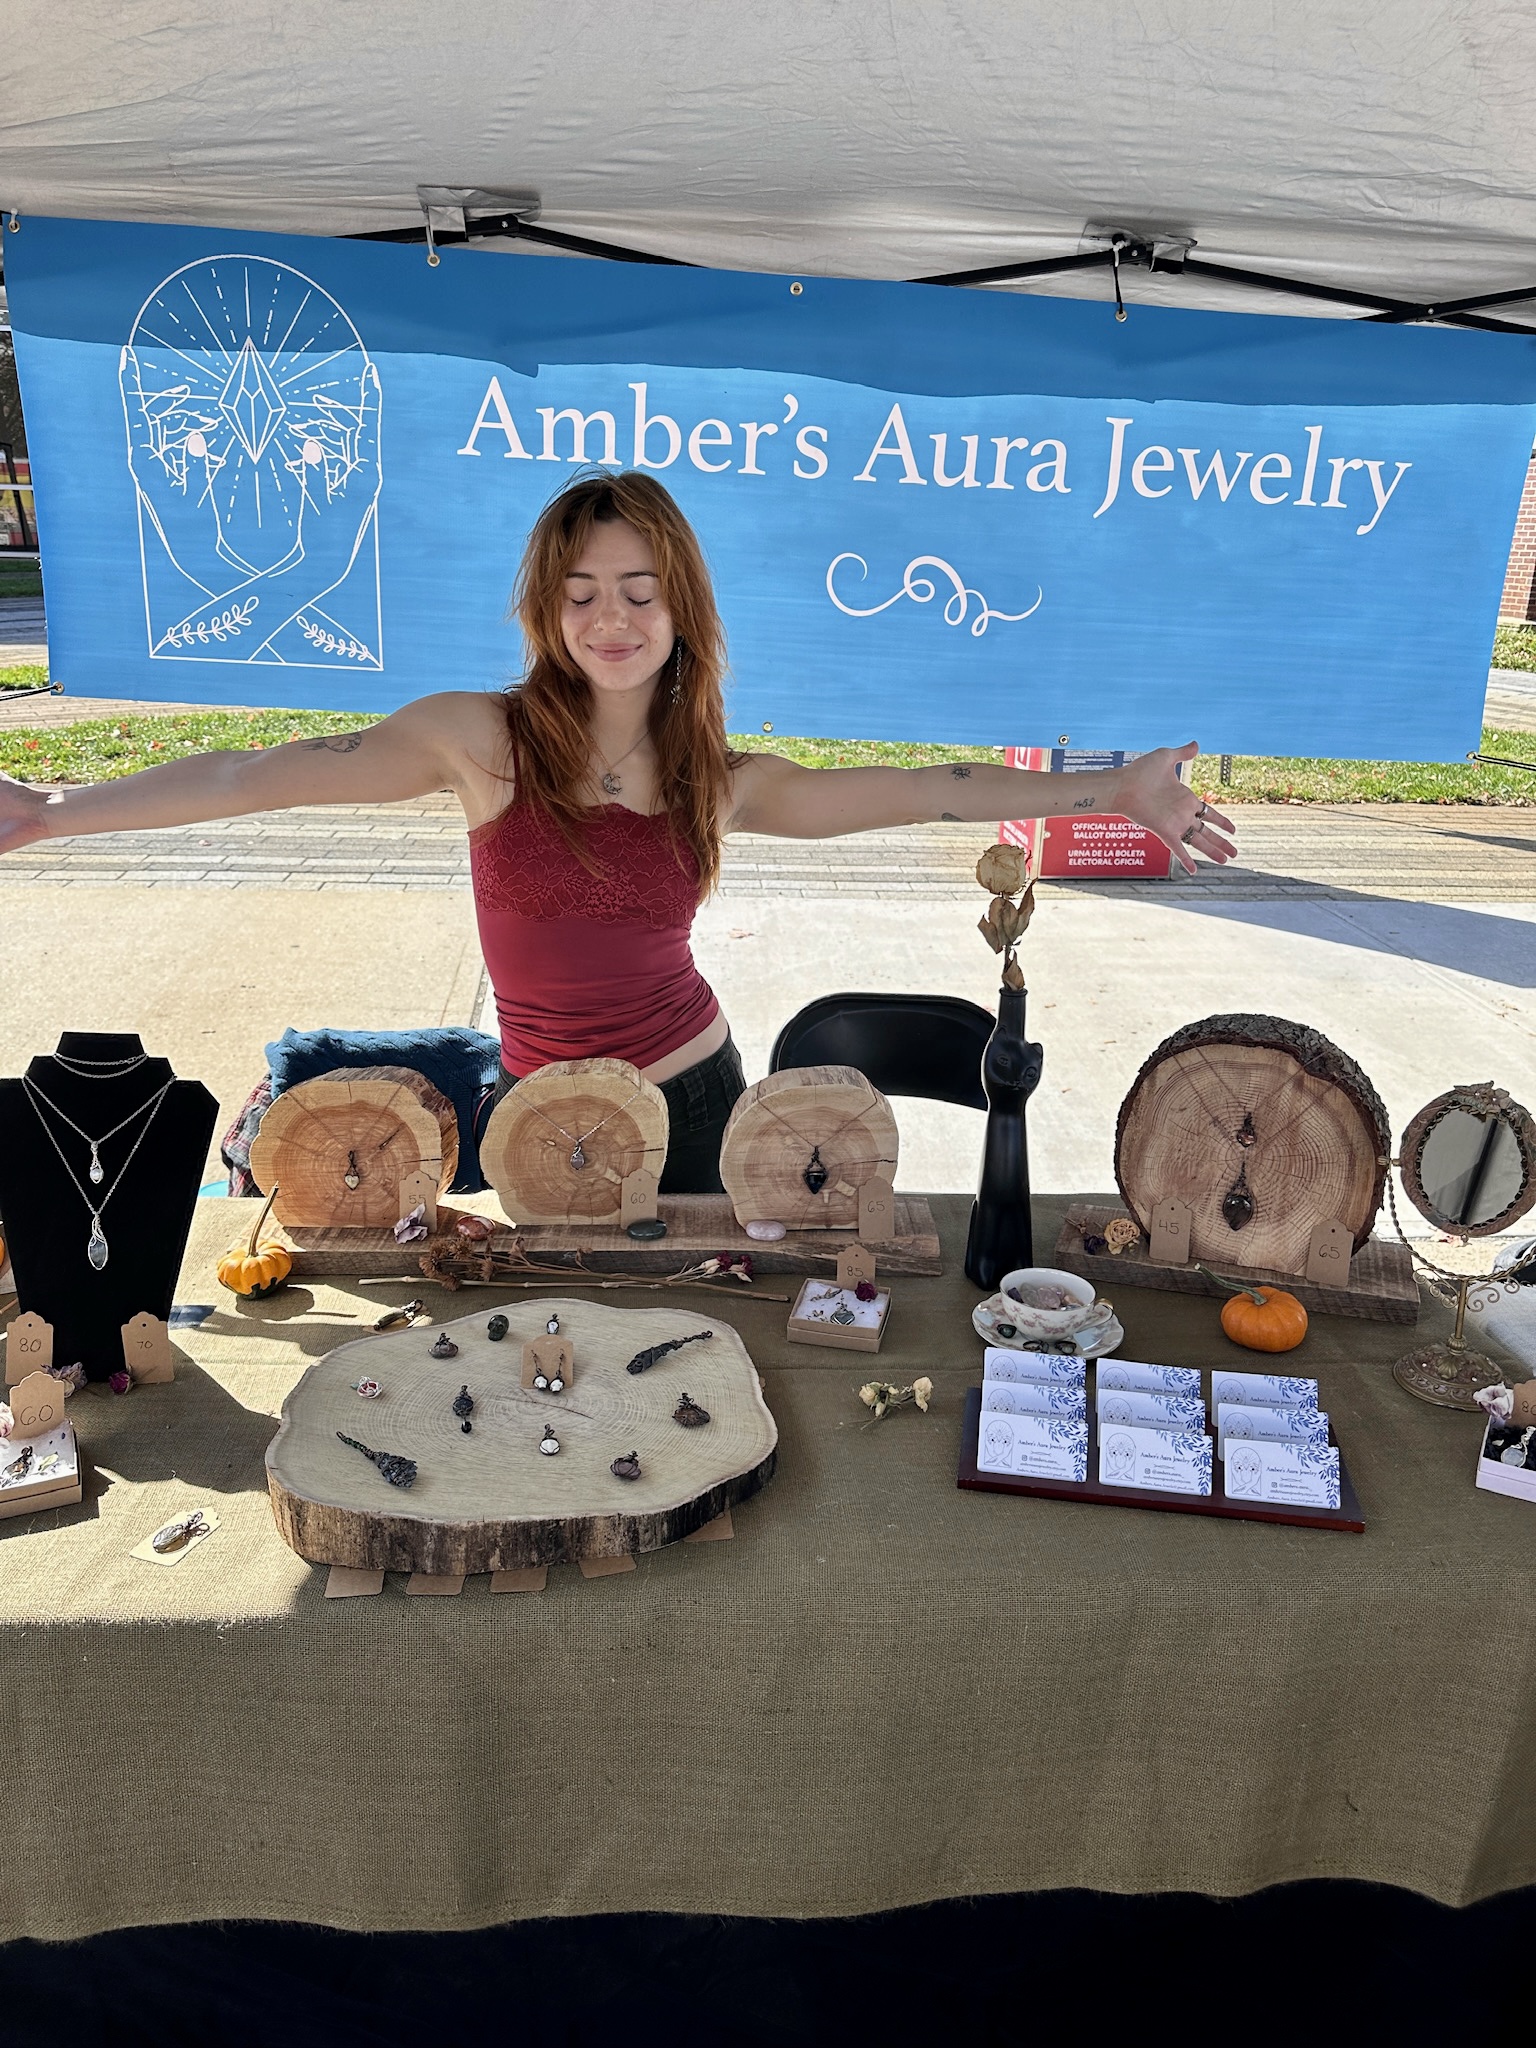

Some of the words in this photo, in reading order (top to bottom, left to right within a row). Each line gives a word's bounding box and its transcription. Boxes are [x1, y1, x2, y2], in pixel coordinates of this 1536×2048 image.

[457, 376, 829, 479] Amber's
[853, 402, 1071, 494] Aura
[1093, 416, 1413, 535] Jewelry
[1071, 823, 1107, 831] OFFICIAL
[1073, 831, 1104, 839] BALLOT
[1068, 849, 1090, 857] URNA
[1068, 858, 1113, 866] ELECTORAL
[1113, 858, 1145, 866] OFICIAL
[408, 1194, 426, 1204] 55
[630, 1192, 646, 1204] 60
[867, 1200, 885, 1213] 65
[1158, 1219, 1180, 1235] 45
[1318, 1244, 1340, 1260] 65
[846, 1266, 864, 1277] 85
[19, 1337, 42, 1352] 80
[136, 1340, 153, 1350] 70
[1280, 1398, 1297, 1406] Jewelry
[20, 1404, 53, 1426] 60
[1167, 1418, 1184, 1426] Jewelry
[1289, 1432, 1306, 1440] Jewelry
[1037, 1441, 1049, 1449] Aura
[1049, 1443, 1066, 1451] Jewelry
[1172, 1455, 1190, 1464] Jewelry
[1299, 1468, 1317, 1477] Jewelry
